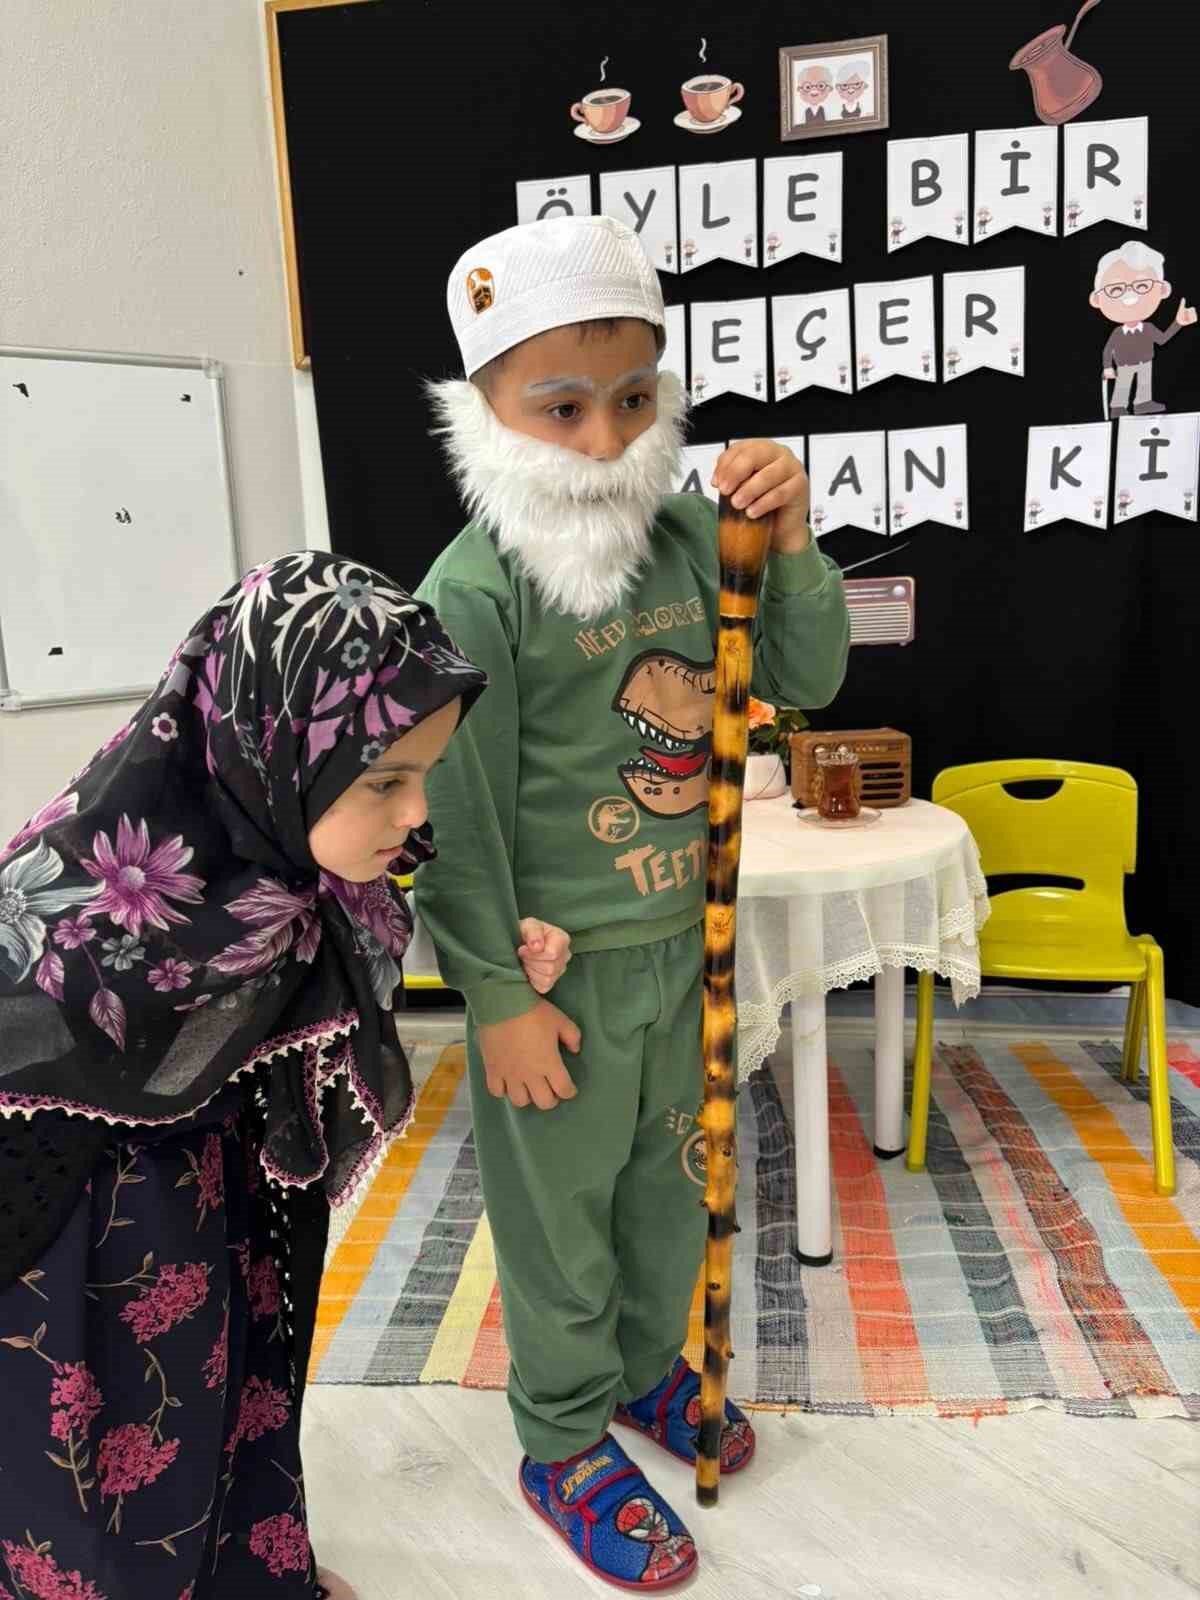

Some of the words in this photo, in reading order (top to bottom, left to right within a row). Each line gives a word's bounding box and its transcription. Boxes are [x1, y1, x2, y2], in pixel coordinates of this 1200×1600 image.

[911, 140, 1121, 207] BİR
[710, 293, 998, 364] EÇER
[1050, 427, 1171, 491] Kİ
[574, 618, 626, 660] NEED
[614, 838, 705, 897] TEET
